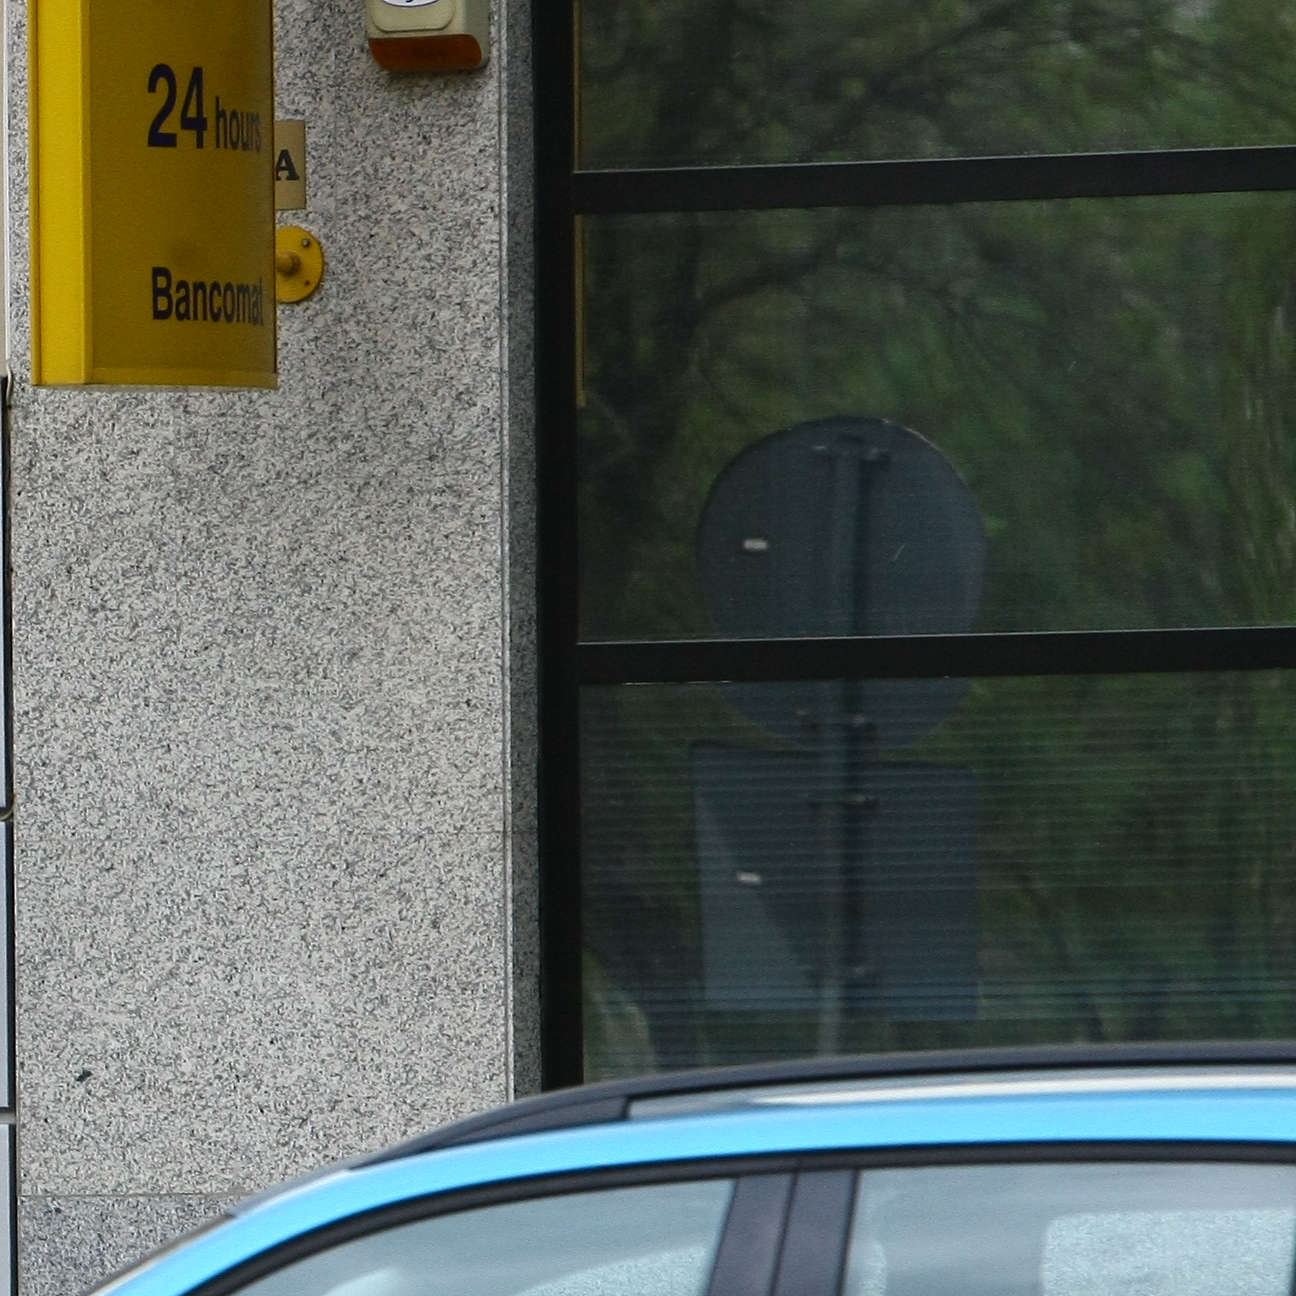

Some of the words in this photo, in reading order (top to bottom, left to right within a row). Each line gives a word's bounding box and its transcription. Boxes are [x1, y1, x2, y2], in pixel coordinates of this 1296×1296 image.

[148, 63, 207, 149] 24
[215, 97, 261, 153] hours
[152, 266, 265, 326] Bancomat
